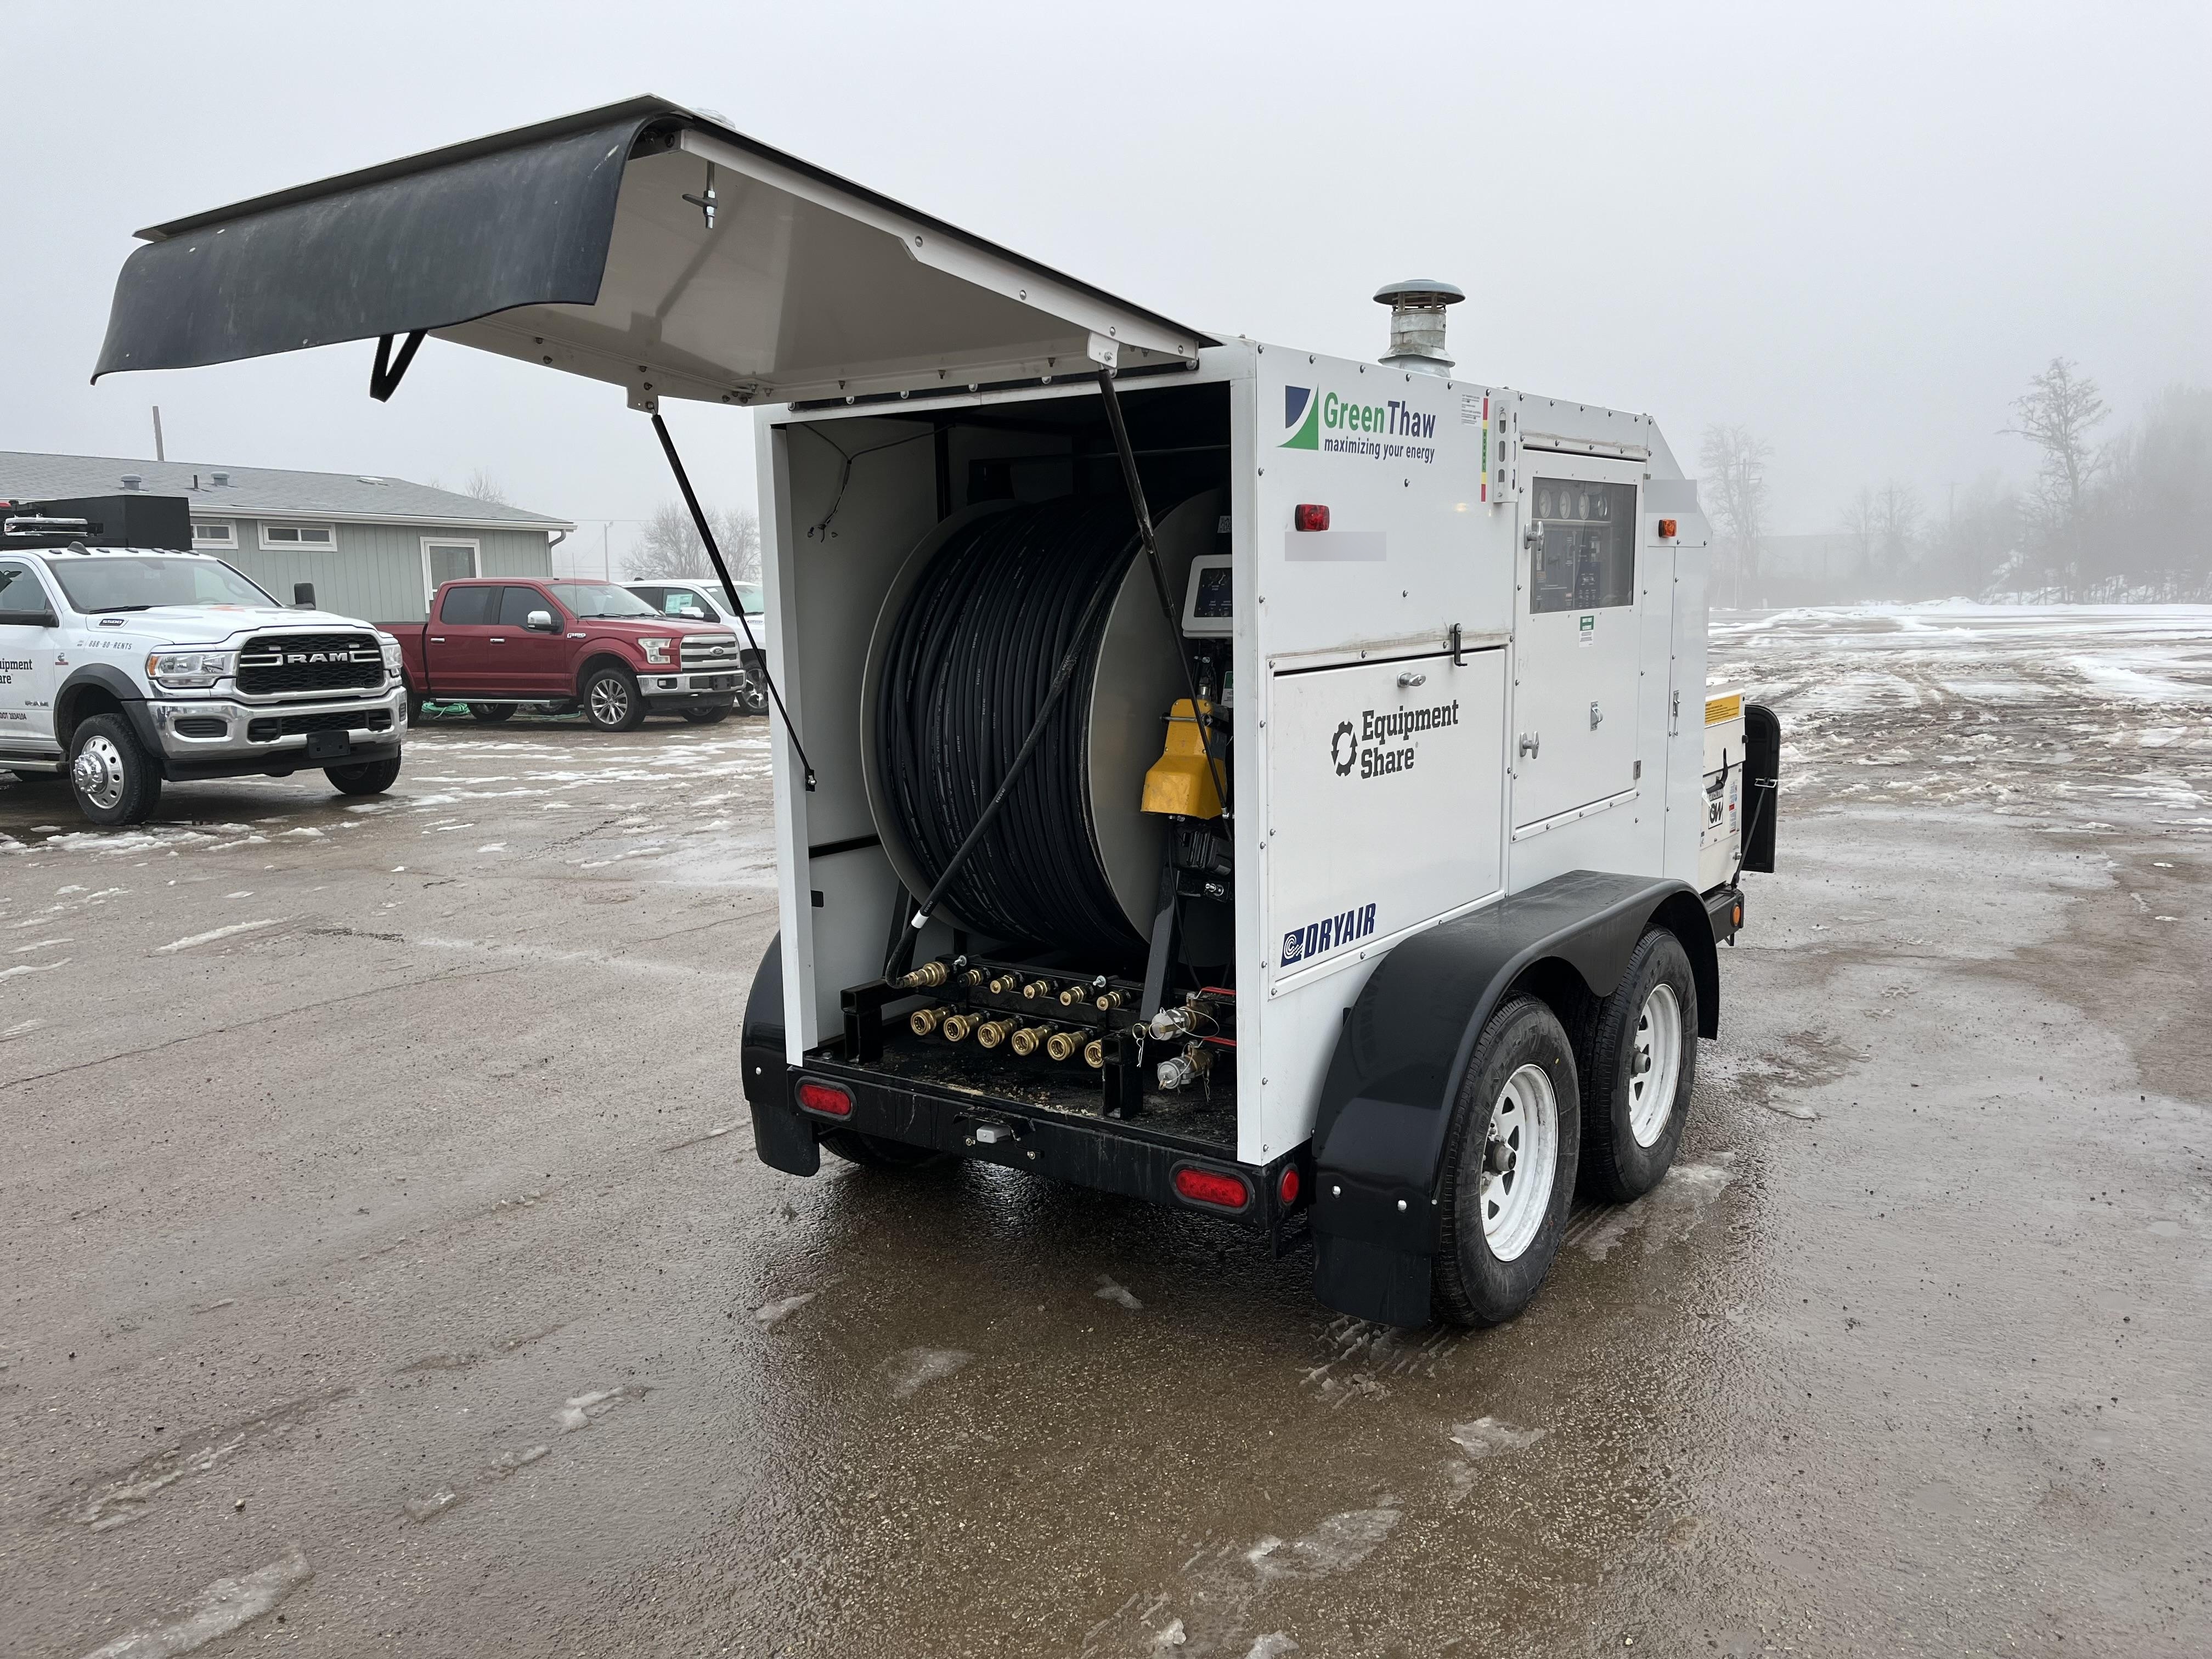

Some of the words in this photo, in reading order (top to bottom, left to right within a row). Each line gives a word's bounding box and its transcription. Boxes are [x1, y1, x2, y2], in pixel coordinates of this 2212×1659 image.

[1324, 436, 1380, 459] maximizing
[1383, 443, 1404, 460] your
[1406, 446, 1435, 464] energy
[287, 653, 348, 663] RAM
[1362, 699, 1459, 745] Equipment
[1361, 747, 1414, 779] Share
[1304, 902, 1376, 959] DRYAIR
